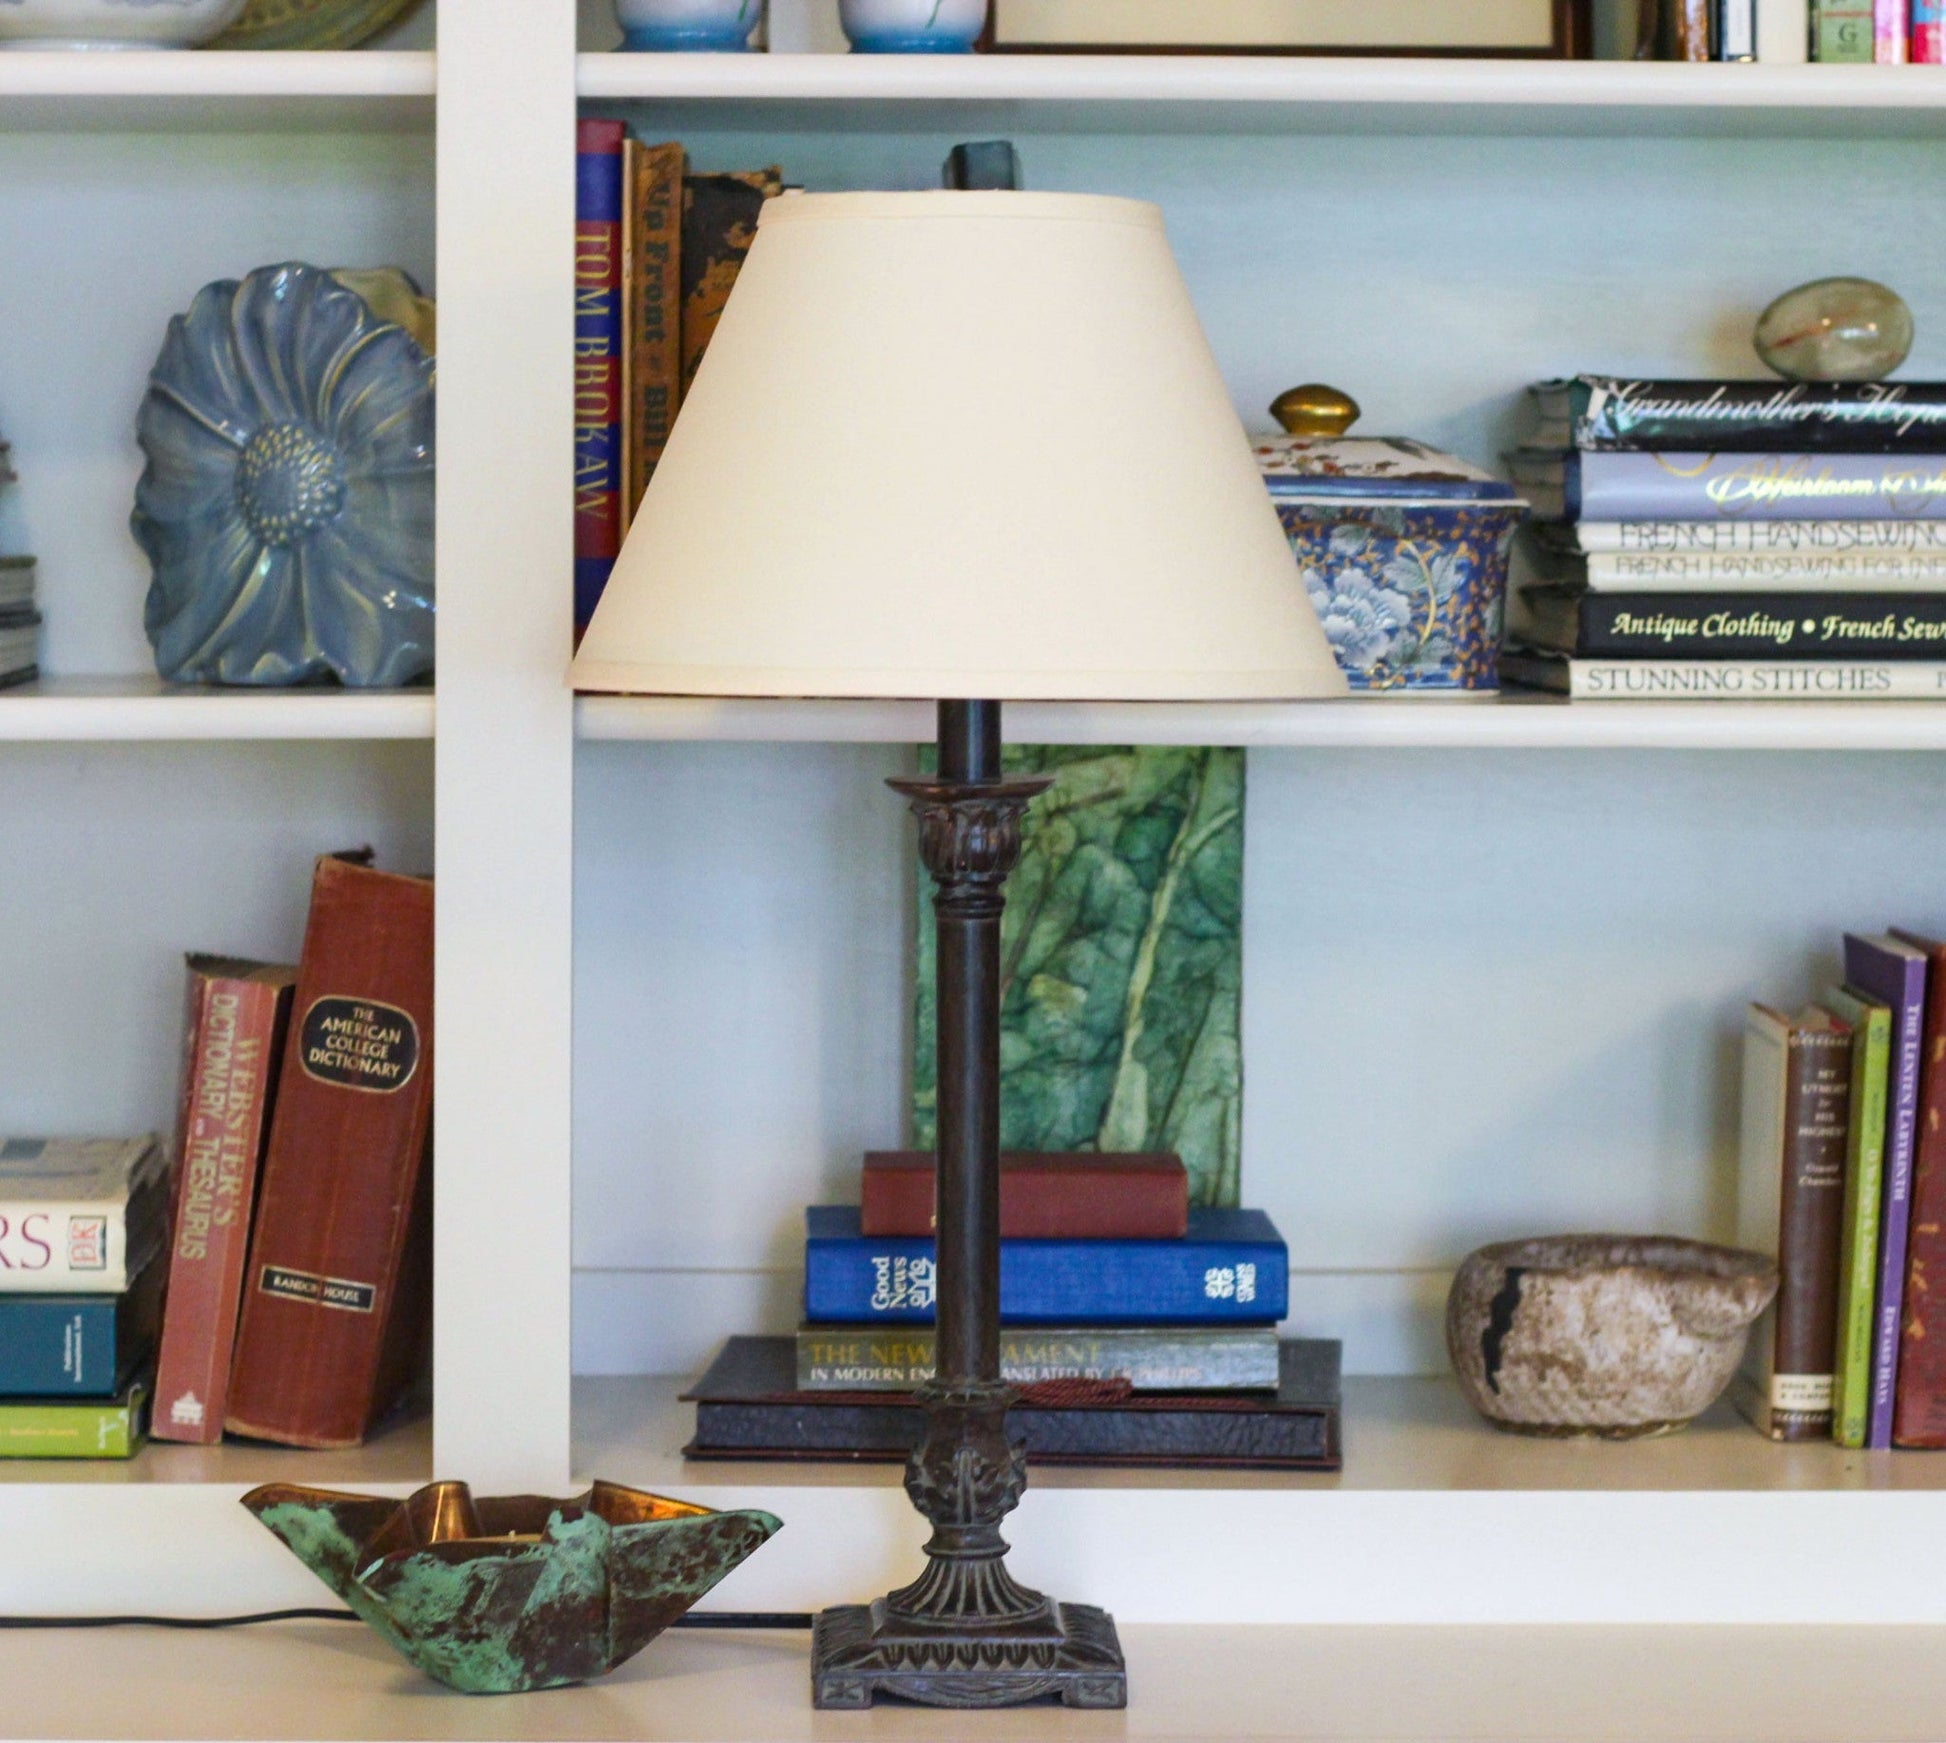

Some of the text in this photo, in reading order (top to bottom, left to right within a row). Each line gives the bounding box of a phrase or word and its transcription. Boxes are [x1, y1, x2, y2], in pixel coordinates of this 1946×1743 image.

[644, 241, 669, 344] Front
[574, 222, 611, 519] TOM BROKAW
[1620, 521, 1737, 551] FRENCH
[1611, 612, 1699, 642] Antique
[1702, 611, 1795, 643] Clothing
[1821, 613, 1896, 641] French
[1588, 667, 1891, 692] STUNNING STITCHES
[321, 1016, 401, 1044] AMERICAN
[353, 1007, 375, 1022] THE
[1906, 1004, 1921, 1036] THE
[326, 1034, 389, 1059] COLLEGE
[309, 1047, 401, 1079] DICTIONARY
[180, 993, 239, 1260] DICTIONARY THESAURUS
[71, 1221, 99, 1262] DK
[871, 1256, 890, 1310] Good
[889, 1256, 907, 1308] News
[811, 1343, 1100, 1366] THE NEW AMENT
[810, 1367, 828, 1381] IN
[834, 1367, 904, 1381] MODERN
